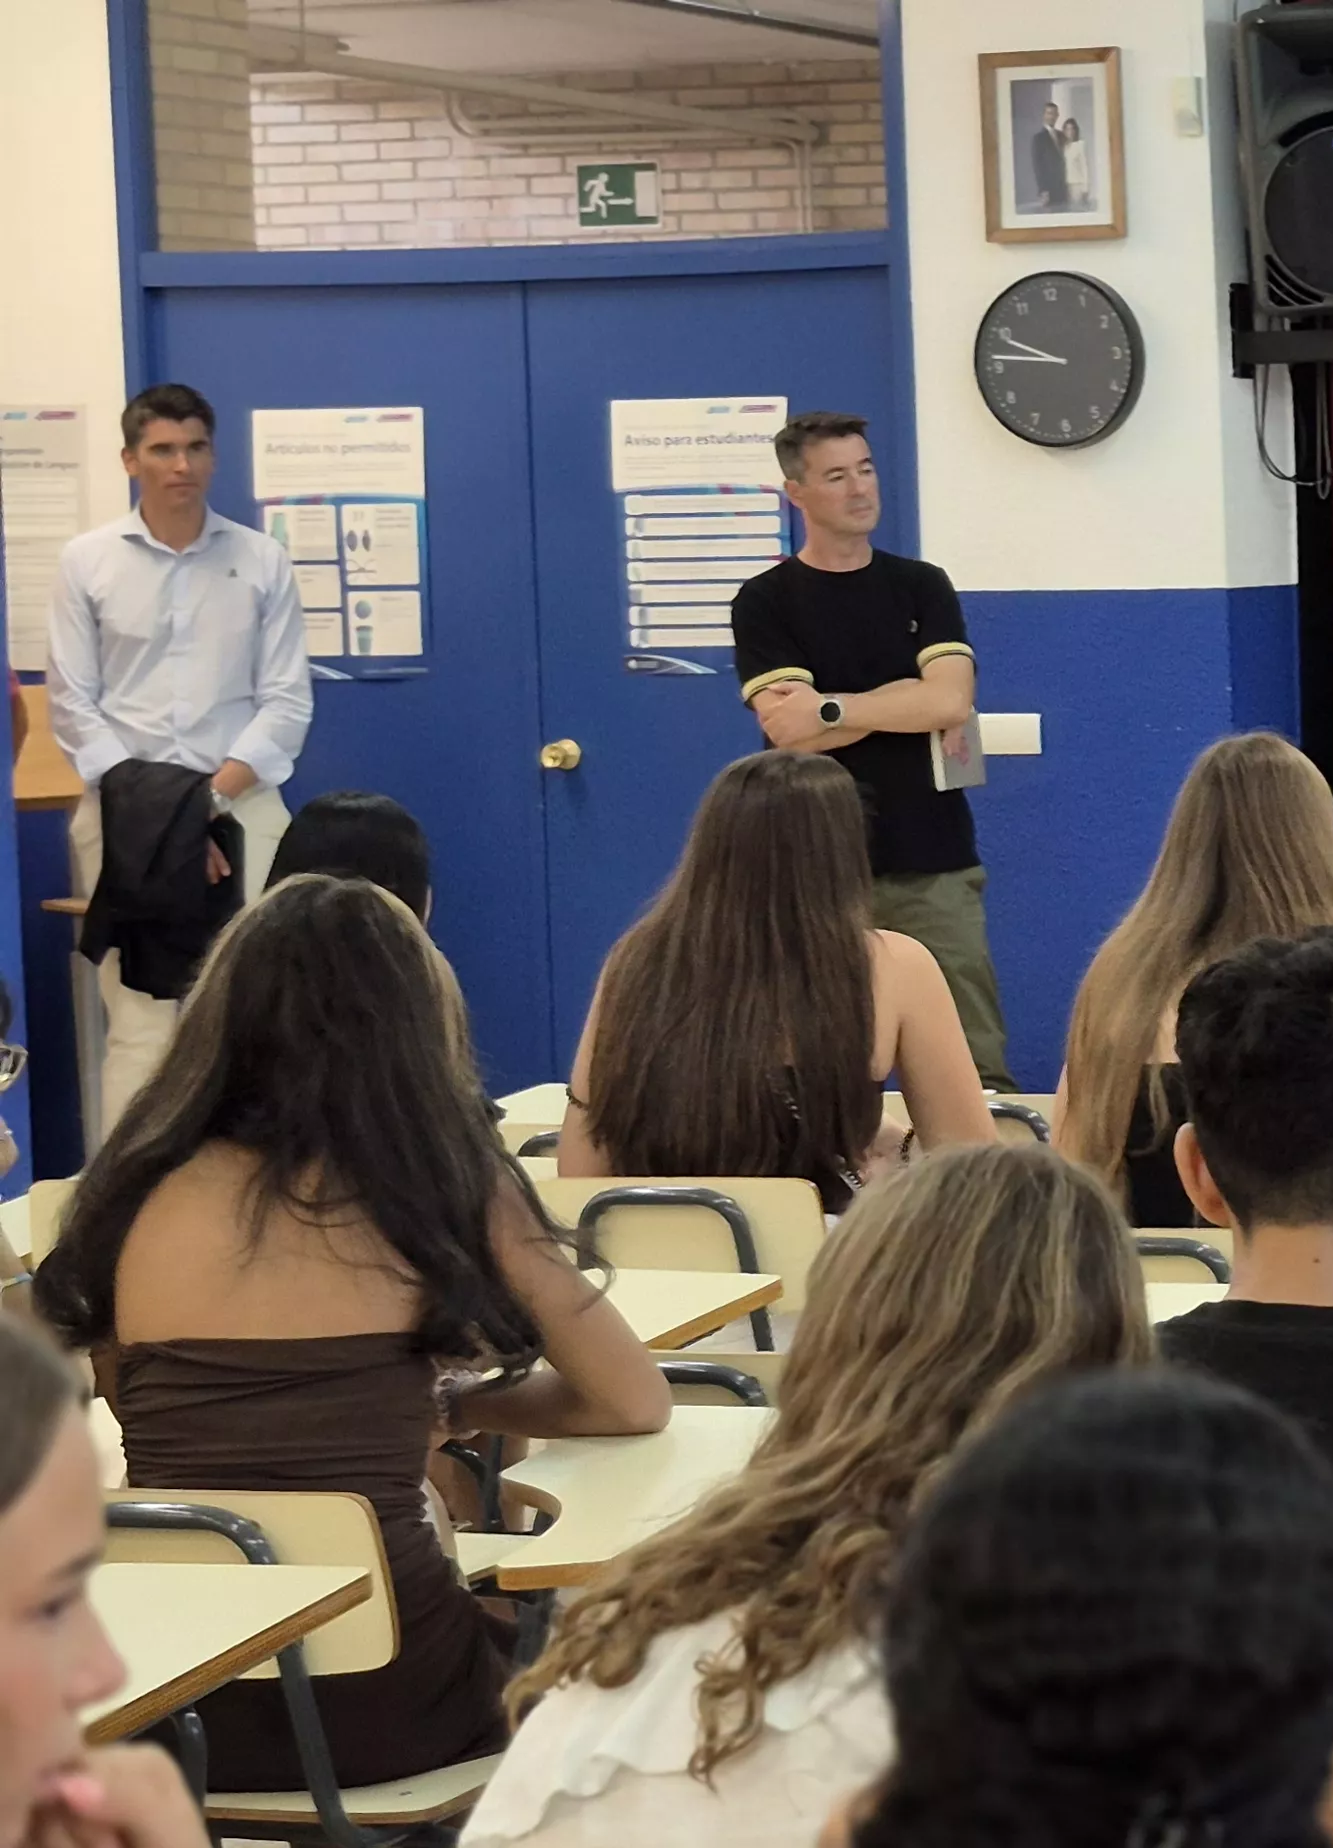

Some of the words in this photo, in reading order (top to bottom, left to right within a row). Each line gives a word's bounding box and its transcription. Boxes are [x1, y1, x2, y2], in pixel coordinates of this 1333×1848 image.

[1043, 288, 1058, 302] 12
[1015, 302, 1029, 316] 11
[1099, 315, 1109, 329] 2
[993, 361, 1005, 374] 9
[1109, 379, 1120, 392] 4
[1005, 390, 1017, 405] 8
[1031, 412, 1041, 426] 7
[1089, 405, 1101, 420] 5
[1060, 418, 1072, 433] 6
[624, 433, 661, 447] Aviso
[663, 435, 693, 449] para
[694, 431, 775, 446] estudiantes
[340, 439, 412, 456] permitidos
